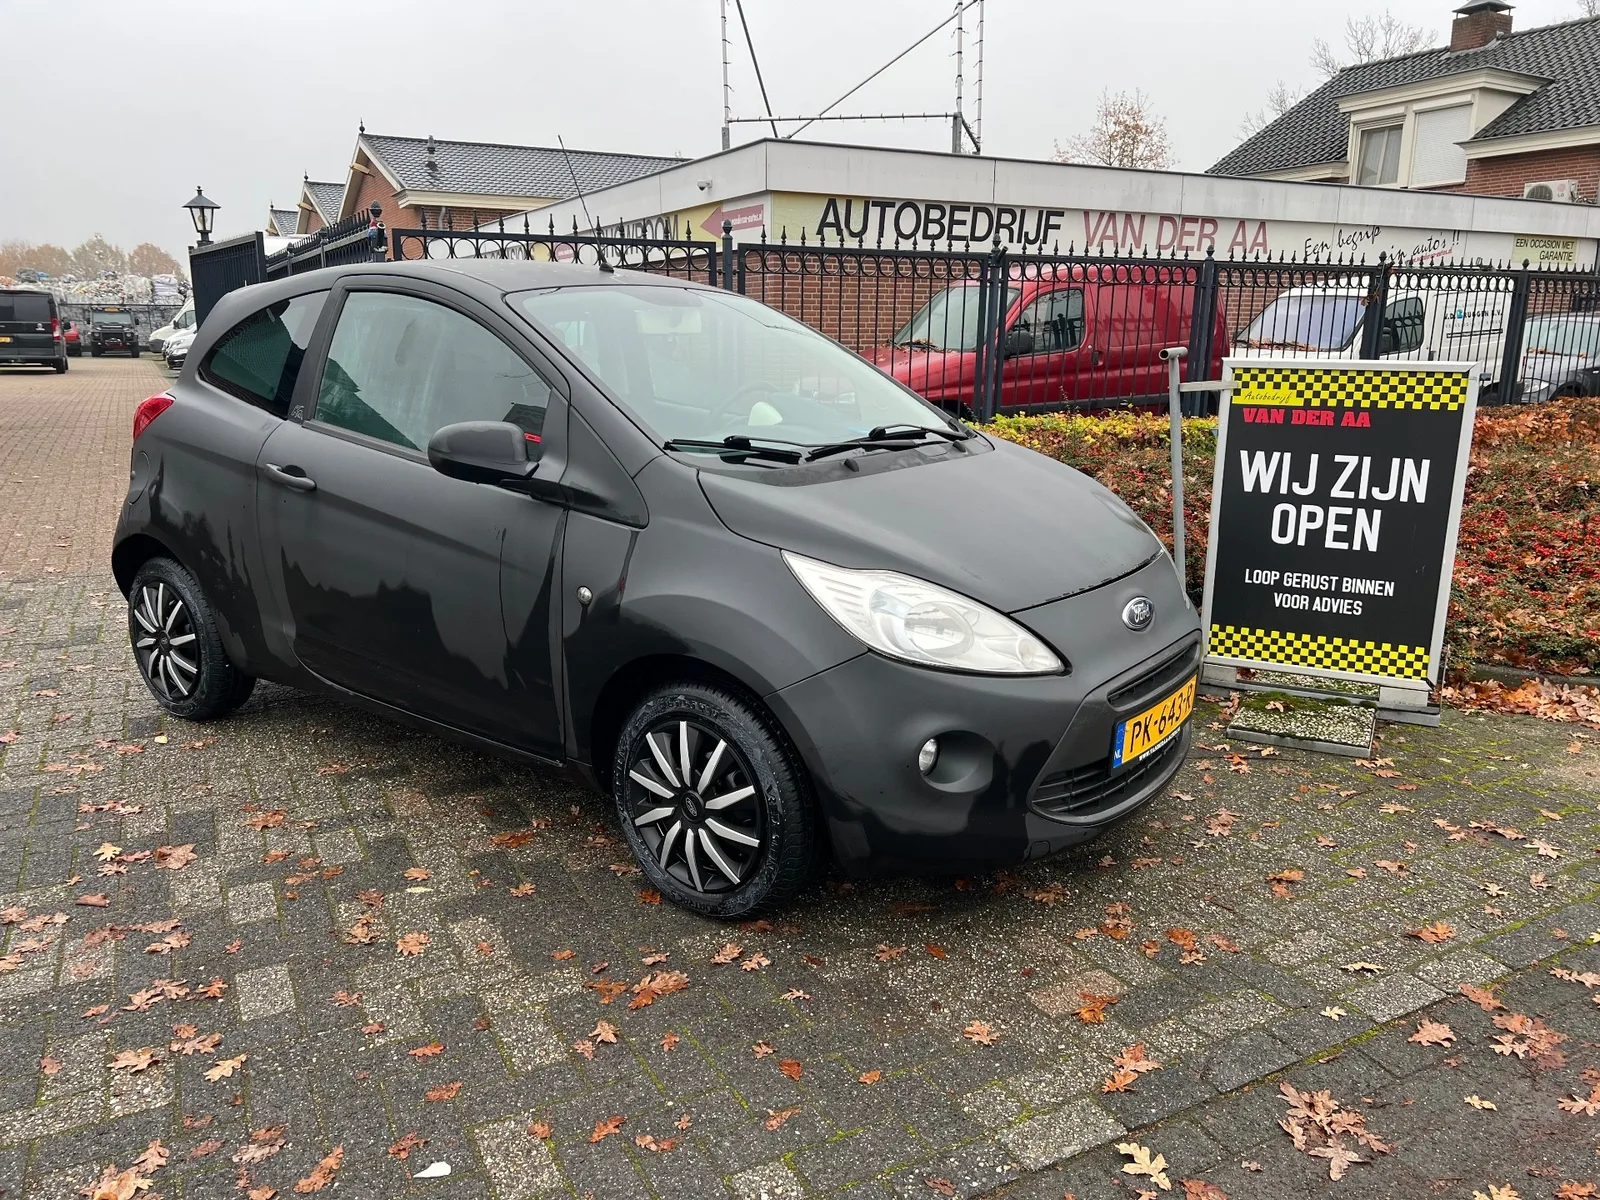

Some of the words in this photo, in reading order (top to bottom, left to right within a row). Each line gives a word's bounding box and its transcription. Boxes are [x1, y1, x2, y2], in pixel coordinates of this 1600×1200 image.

[816, 198, 1065, 245] AUTOBEDRIJF
[1083, 211, 1145, 249] VAN
[1156, 215, 1218, 252] DER
[1227, 220, 1268, 254] AA
[1305, 238, 1330, 257] Een
[1337, 225, 1381, 250] begrip
[1516, 239, 1528, 248] EEN
[1530, 239, 1561, 249] OCCASION
[1561, 241, 1575, 250] MET
[1388, 245, 1407, 262] in
[1540, 250, 1574, 261] GARANTIE
[1244, 391, 1292, 404] Autobedrijf
[1243, 407, 1285, 424] VAN
[1291, 409, 1335, 426] DER
[1341, 411, 1371, 427] AA
[1240, 450, 1319, 496] WIJ
[1330, 454, 1431, 504] ZIJN
[1271, 503, 1382, 552] OPEN
[1244, 568, 1280, 586] LOOP
[1283, 572, 1339, 591] GERUST
[1342, 578, 1395, 597] BINNEN
[1274, 592, 1310, 611] VOOR
[1312, 596, 1363, 616] ADVIES
[1130, 683, 1193, 753] PK-643-R
[1114, 749, 1122, 761] NL
